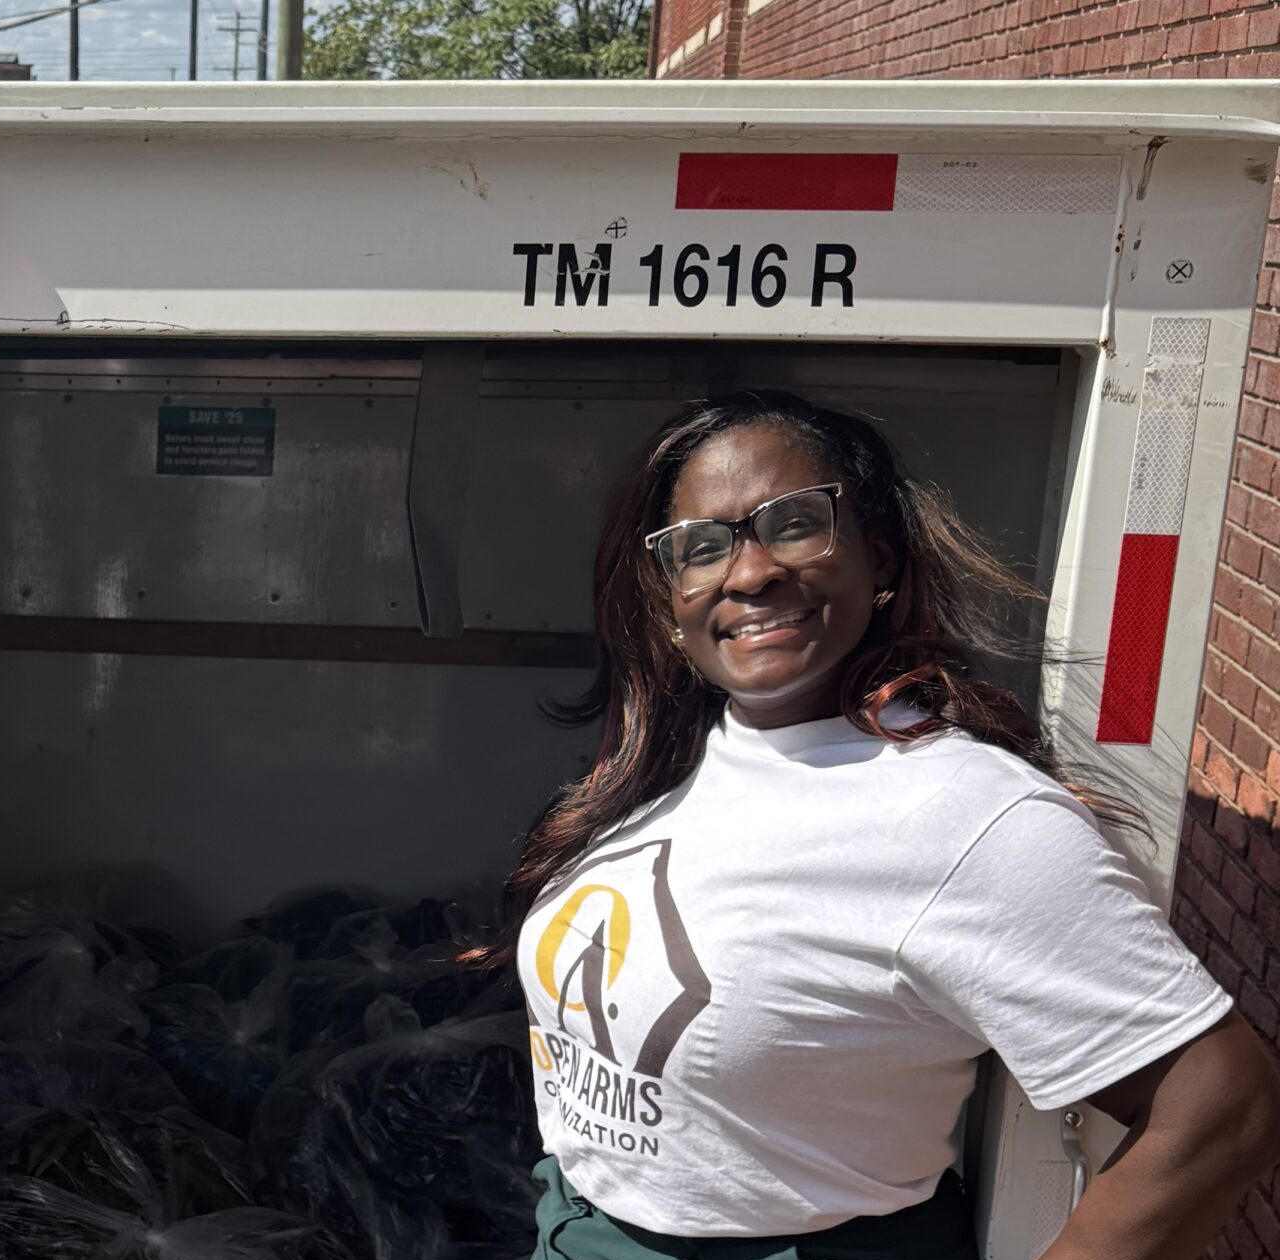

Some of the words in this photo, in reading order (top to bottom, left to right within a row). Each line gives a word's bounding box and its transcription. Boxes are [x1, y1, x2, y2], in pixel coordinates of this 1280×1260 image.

[512, 242, 613, 306] TM
[639, 242, 787, 308] 1616
[811, 242, 856, 307] R
[188, 410, 220, 424] SAVE
[544, 1080, 659, 1157] ONIZATION
[578, 1056, 662, 1127] ARMS
